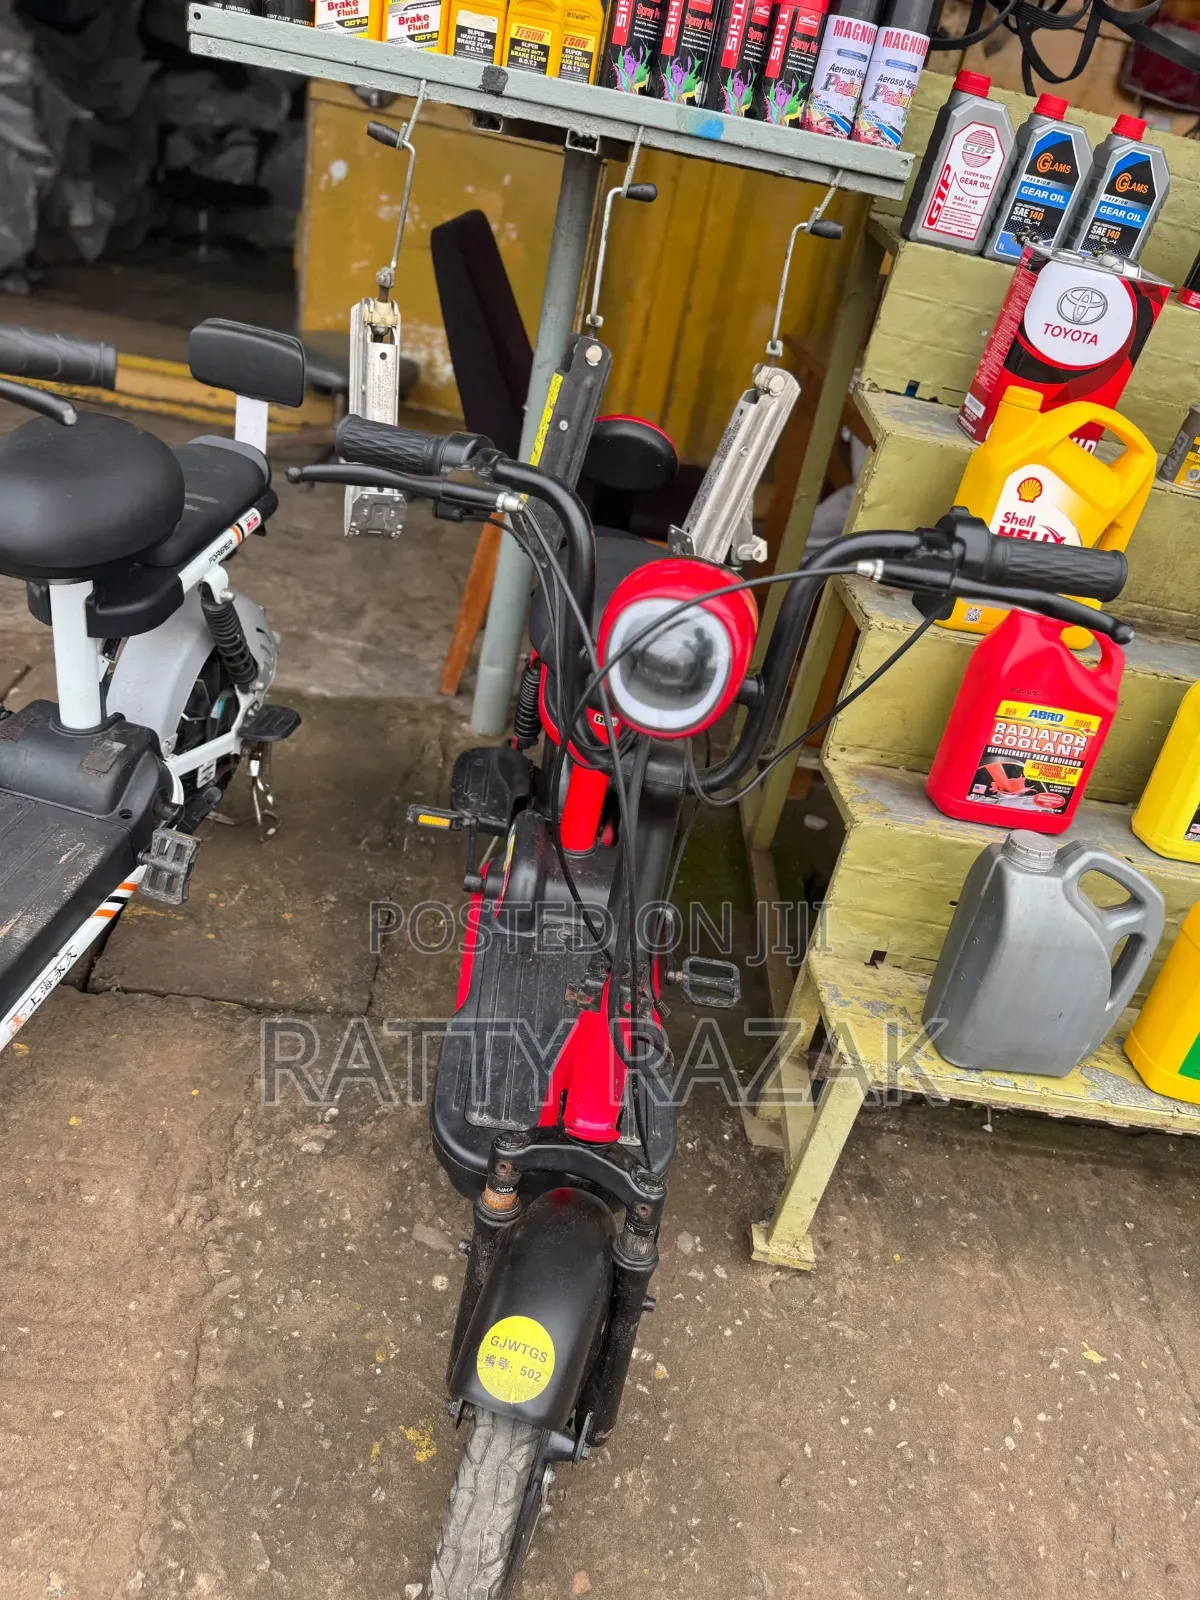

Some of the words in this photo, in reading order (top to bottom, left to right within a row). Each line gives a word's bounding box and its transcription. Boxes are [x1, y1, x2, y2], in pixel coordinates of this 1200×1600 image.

[327, 0, 359, 11] Brake
[336, 6, 359, 18] Fluid
[398, 13, 430, 26] Brake
[407, 22, 430, 32] Fluid
[665, 1, 680, 38] HIS
[684, 12, 704, 29] Spray
[466, 28, 485, 38] SUPER
[514, 25, 544, 43] TESON
[770, 9, 790, 61] THIS
[456, 38, 475, 46] BRAKE
[474, 42, 493, 51] FLUID
[520, 41, 539, 51] SUPER
[563, 34, 588, 49] ESON
[790, 36, 810, 51] Spray
[510, 50, 530, 60] BRAKE
[529, 54, 547, 64] FLUID
[564, 48, 583, 57] SUPER
[828, 63, 857, 77] Aerosol
[876, 73, 907, 87] Aerosol
[959, 176, 978, 187] GEAR
[979, 182, 991, 190] OIL
[963, 170, 980, 178] SUPER
[979, 173, 993, 181] DUTY
[1021, 186, 1048, 200] GEAR
[1049, 193, 1066, 204] OIL
[1013, 206, 1030, 218] SAE
[1029, 210, 1044, 221] 140
[1099, 205, 1126, 219] GEAR
[1126, 212, 1142, 223] OIL
[1090, 225, 1107, 237] SAE
[1106, 229, 1120, 240] 140
[1043, 323, 1099, 346] TOYOTA
[1001, 511, 1036, 528] Shell
[1027, 709, 1065, 723] ABRO
[1073, 719, 1092, 729] ROJO
[993, 722, 1088, 748] RADIATOR
[991, 733, 1086, 758] COOLANT
[986, 746, 1031, 759] REFRIGERANTE
[1032, 754, 1049, 762] PARA
[1049, 756, 1082, 768] RADIADOR
[490, 1335, 548, 1363] GJWTGS
[519, 1365, 542, 1382] 502
